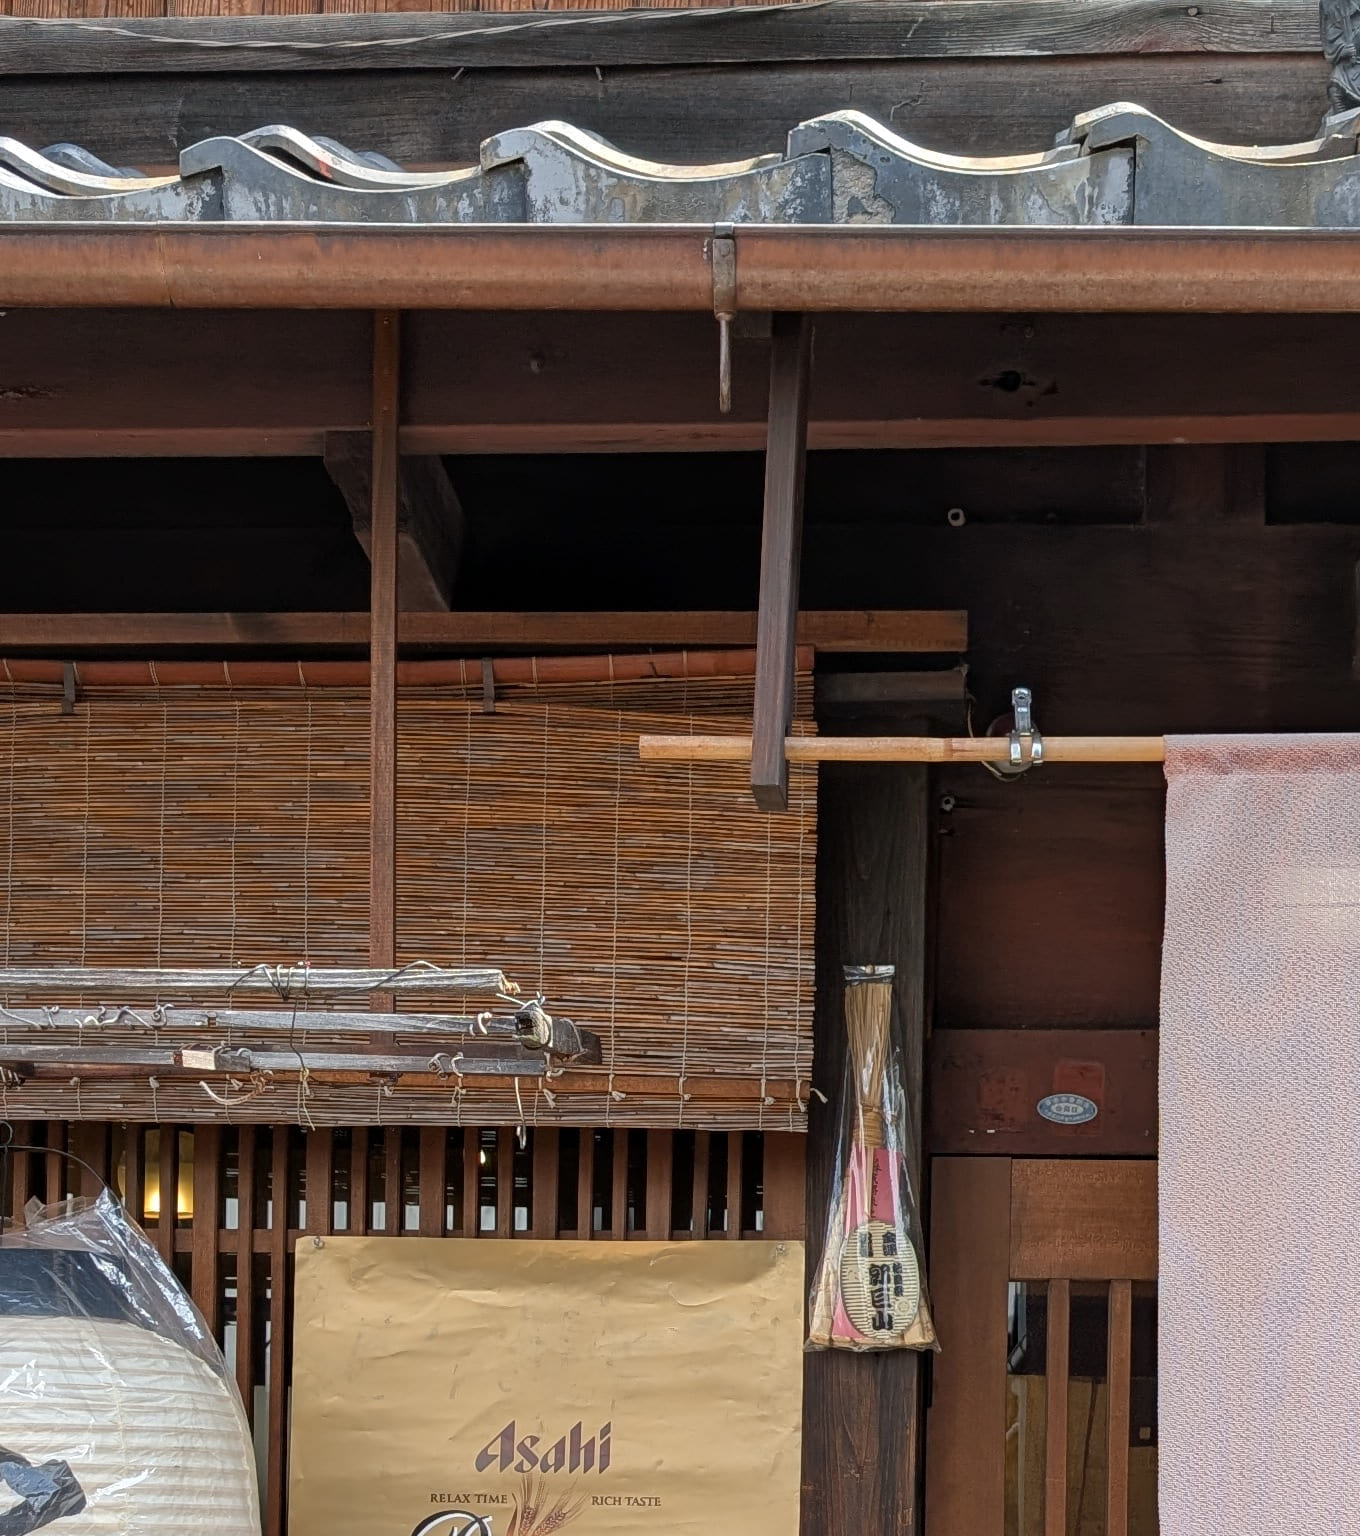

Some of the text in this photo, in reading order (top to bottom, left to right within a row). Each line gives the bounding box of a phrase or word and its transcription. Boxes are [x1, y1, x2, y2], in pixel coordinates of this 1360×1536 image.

[475, 1420, 611, 1474] Asahi
[430, 1493, 507, 1504] RELAX TIME
[592, 1496, 661, 1506] RICH TASTE
